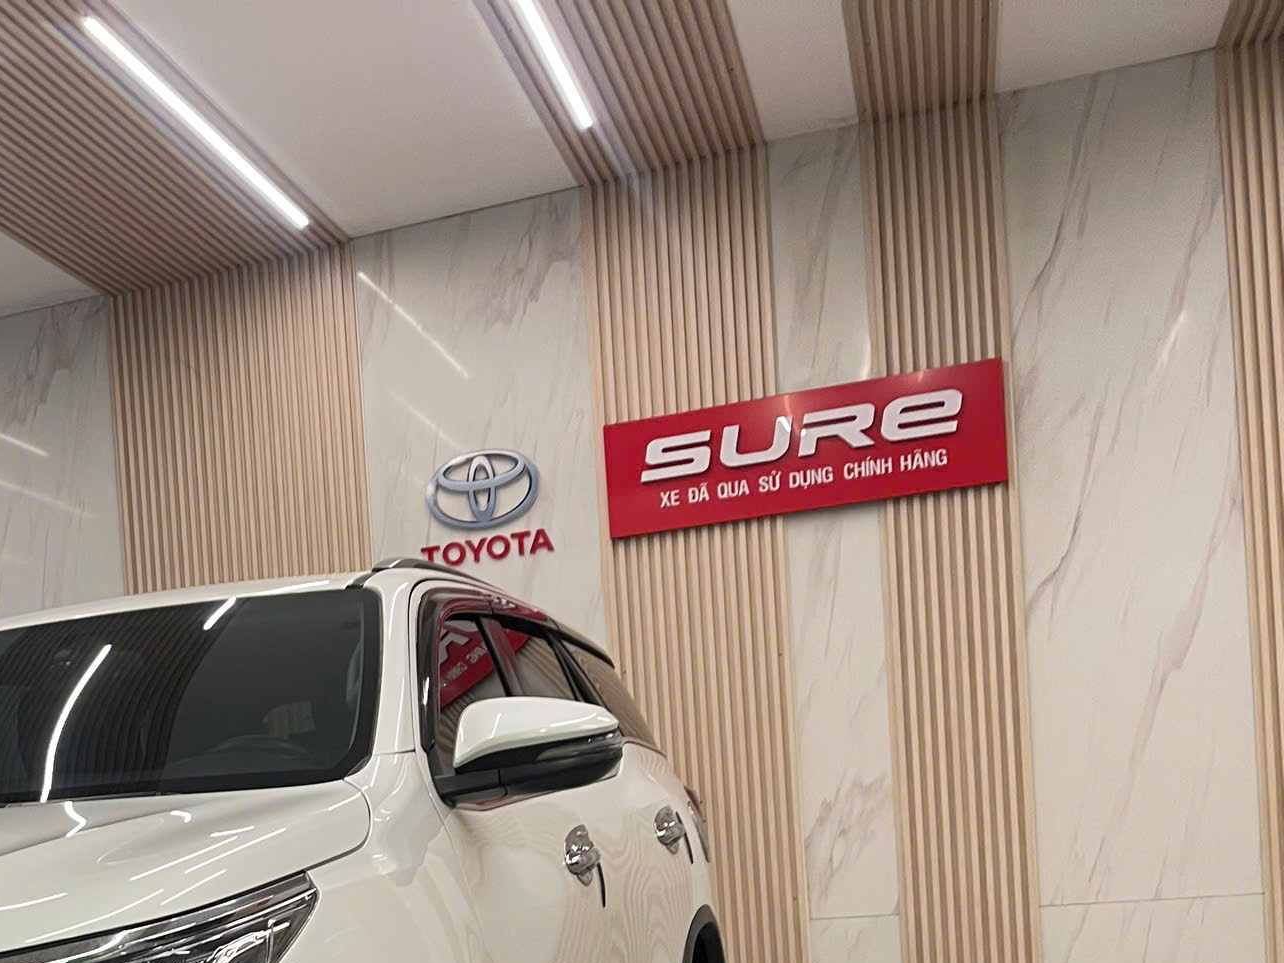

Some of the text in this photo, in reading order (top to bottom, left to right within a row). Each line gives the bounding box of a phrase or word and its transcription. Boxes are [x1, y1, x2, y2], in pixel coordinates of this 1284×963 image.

[659, 448, 949, 508] XE ĐÃ QUA SỬ DỤNG CHÍNH HÃNG
[419, 528, 555, 567] TOYOTA
